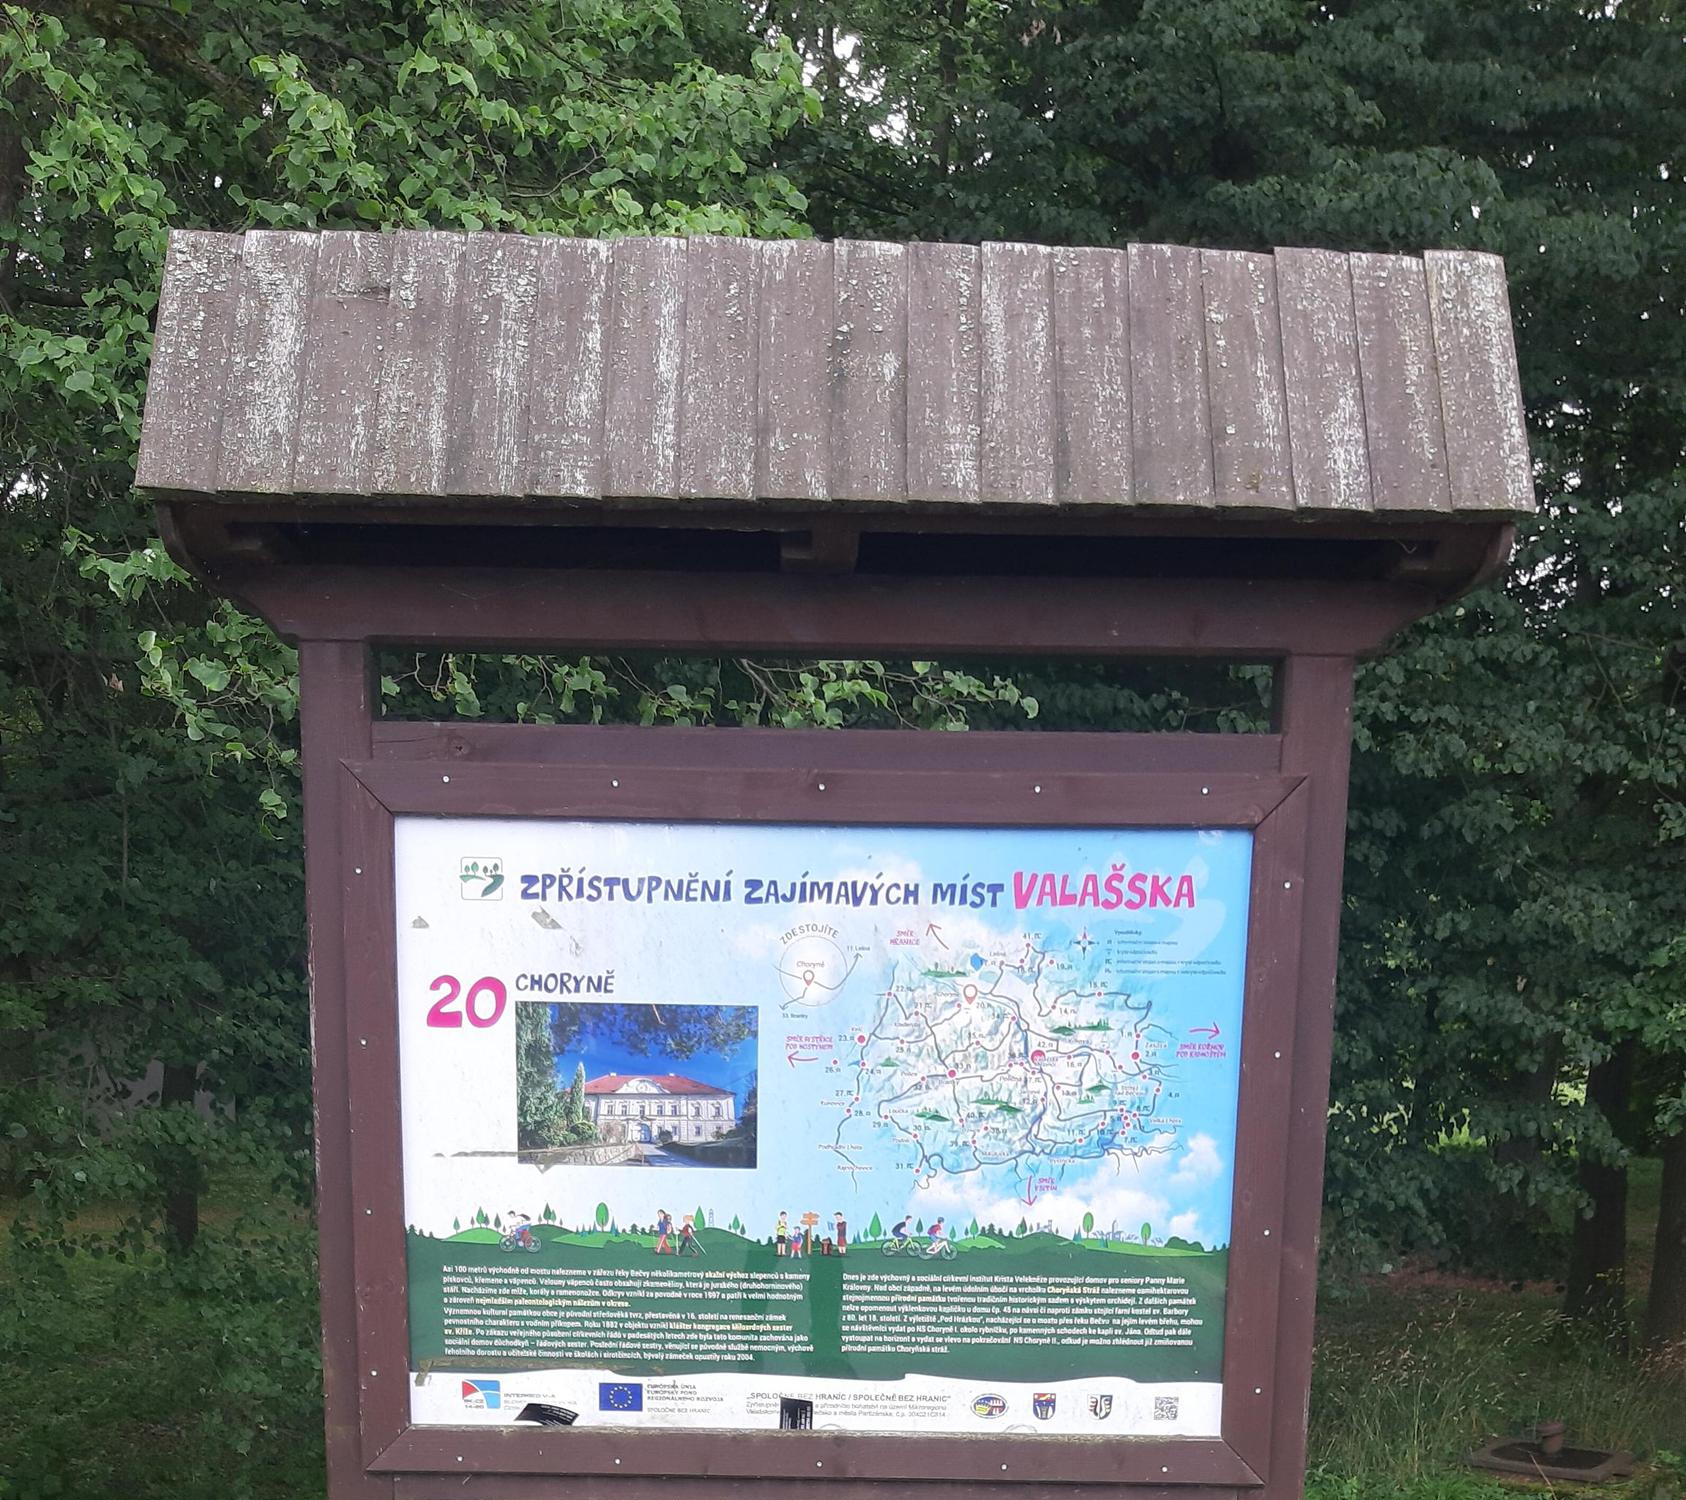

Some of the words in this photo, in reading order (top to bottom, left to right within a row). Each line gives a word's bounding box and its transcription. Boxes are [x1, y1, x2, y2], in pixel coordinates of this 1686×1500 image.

[520, 867, 734, 904] ZPŘÍSTUPNĚNÍ
[744, 870, 919, 906] ZAJÍMAVÝCH
[932, 873, 1004, 908] MÍST
[1013, 863, 1196, 909] VALAŠSKA
[779, 927, 798, 945] ZDE
[799, 923, 839, 938] STOJÍTE
[515, 970, 615, 994] CHORYNĚ
[426, 974, 507, 1028] 20
